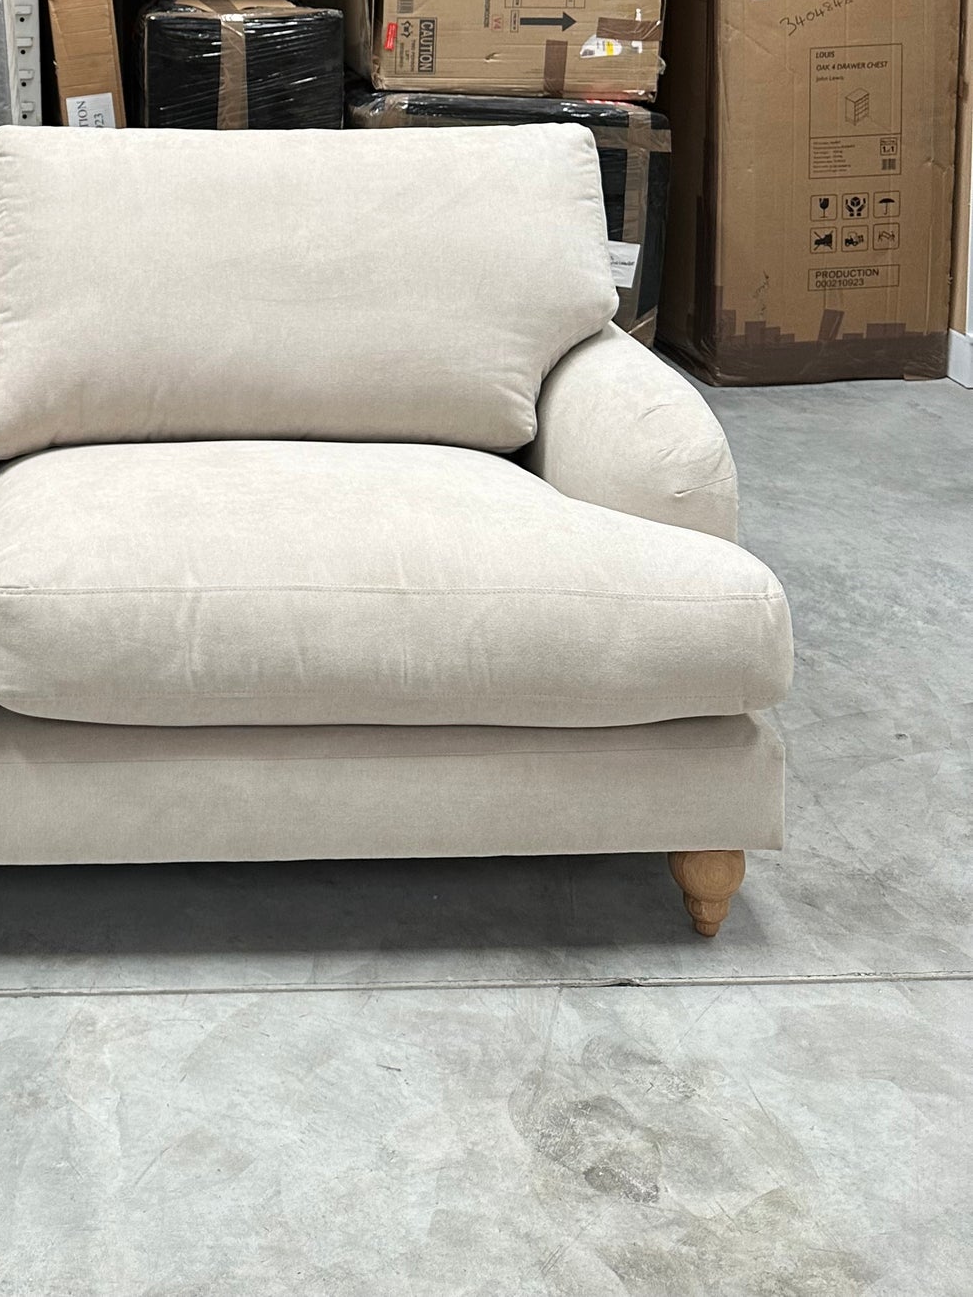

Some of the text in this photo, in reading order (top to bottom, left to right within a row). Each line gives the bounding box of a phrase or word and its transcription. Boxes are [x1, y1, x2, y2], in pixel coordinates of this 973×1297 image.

[493, 18, 501, 30] V4
[419, 22, 434, 70] CAUTION
[867, 61, 888, 69] CHEST
[816, 268, 879, 279] PRODUCTION
[816, 278, 864, 288] 000210923
